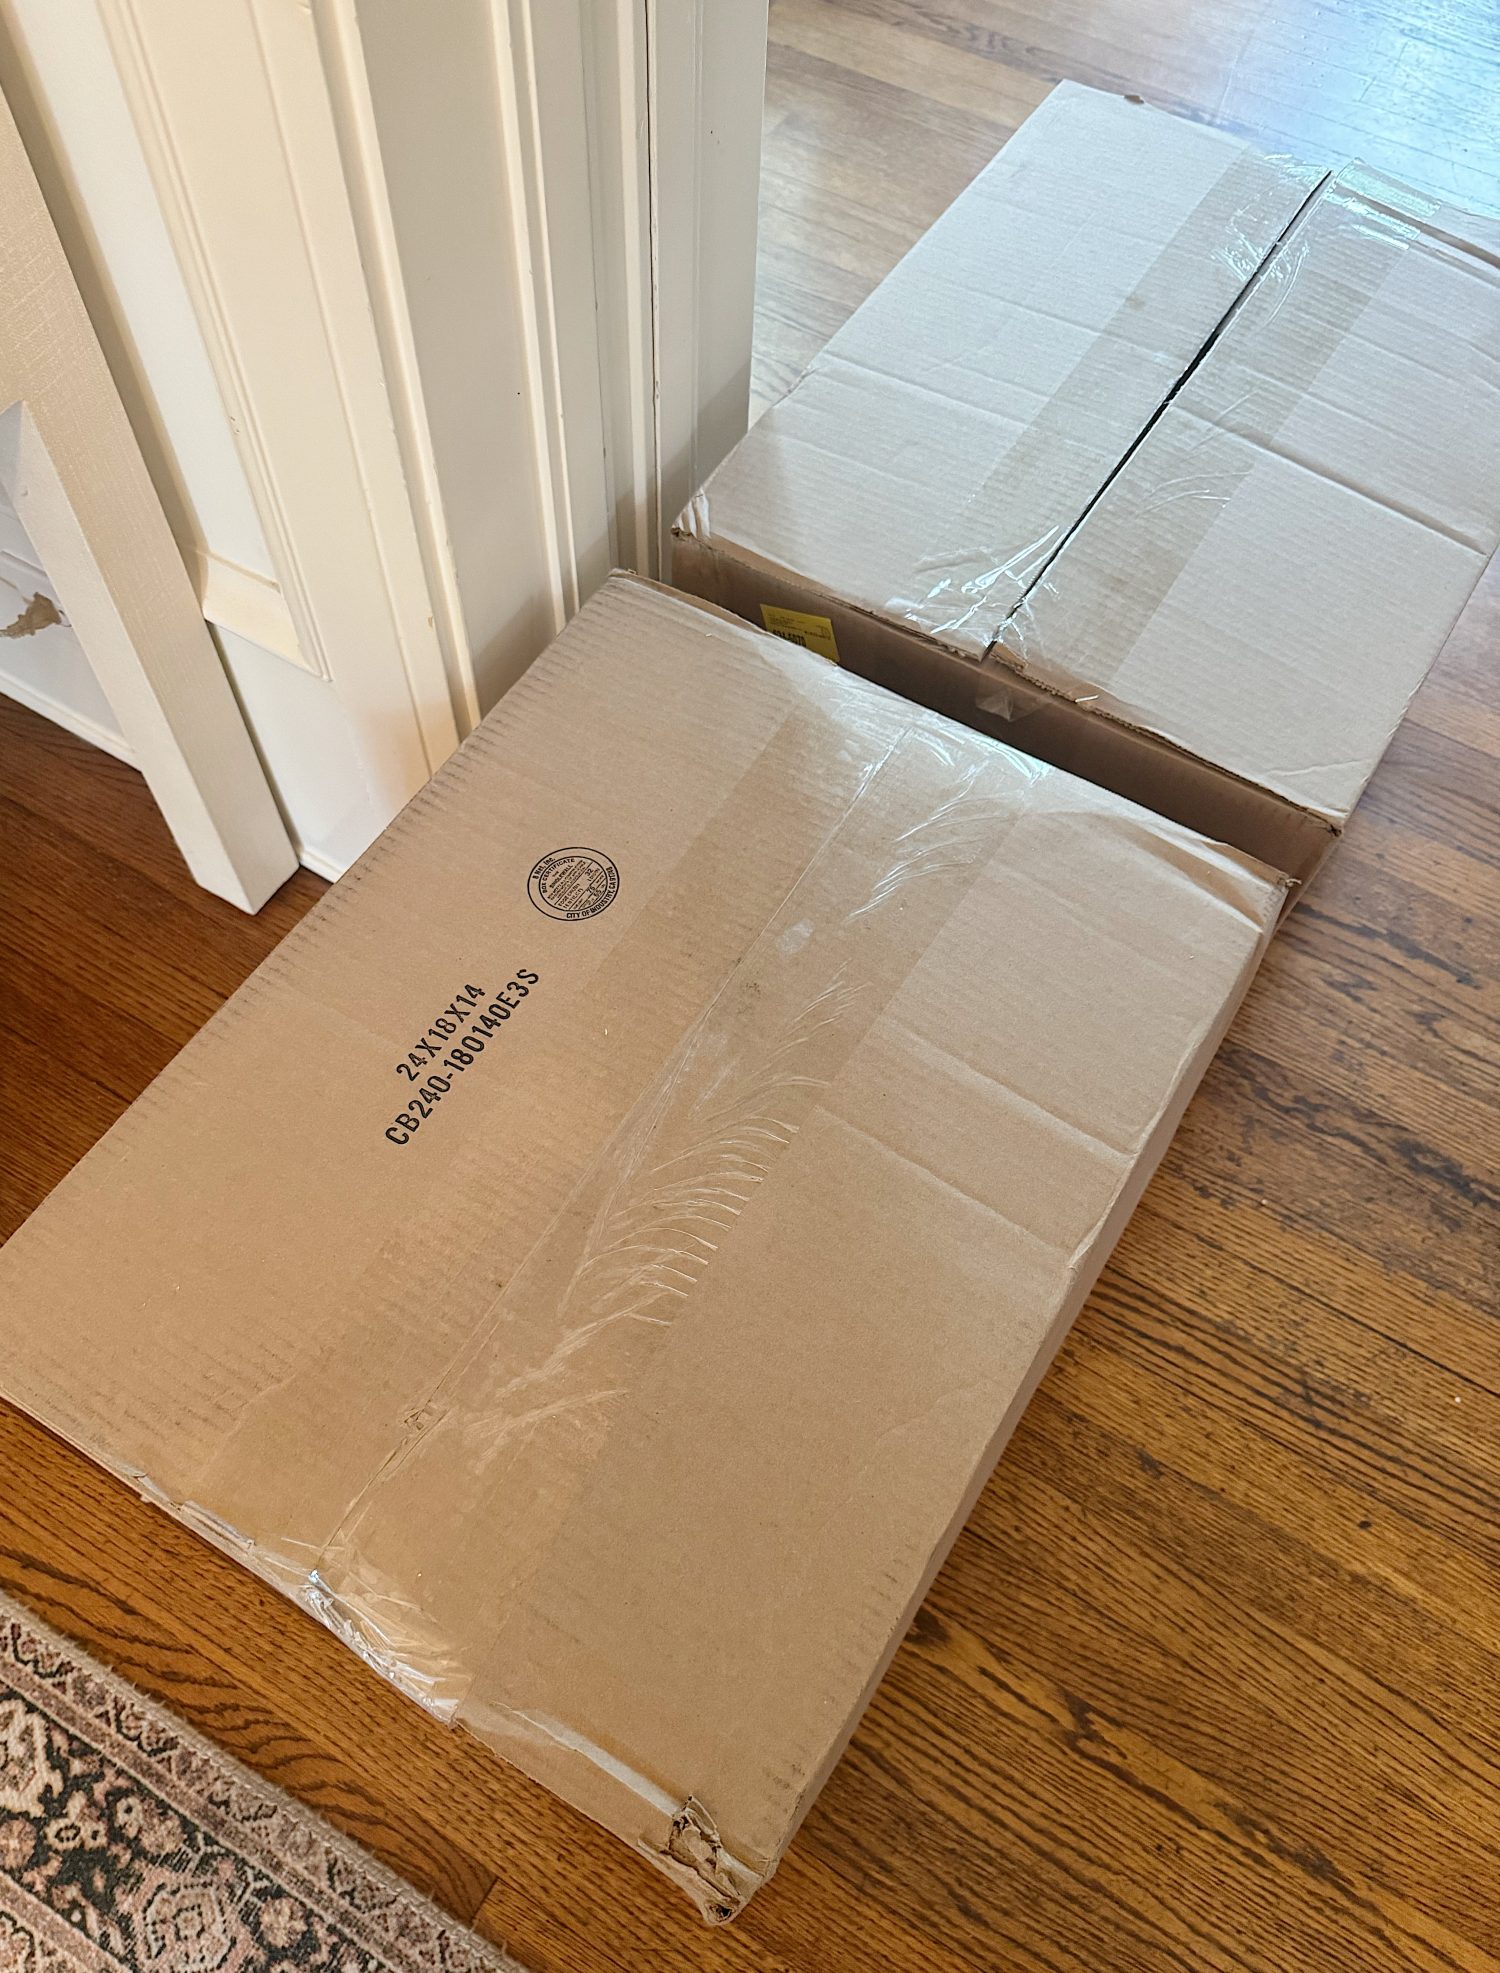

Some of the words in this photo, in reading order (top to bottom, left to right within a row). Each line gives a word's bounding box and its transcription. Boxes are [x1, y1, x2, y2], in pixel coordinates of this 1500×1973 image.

[542, 858, 575, 881] CERTIFICATE
[585, 868, 594, 876] 32
[589, 889, 615, 914] INDUSTRY,
[396, 984, 486, 1081] 24X18X14
[385, 968, 539, 1145] CB240-180140E3S
